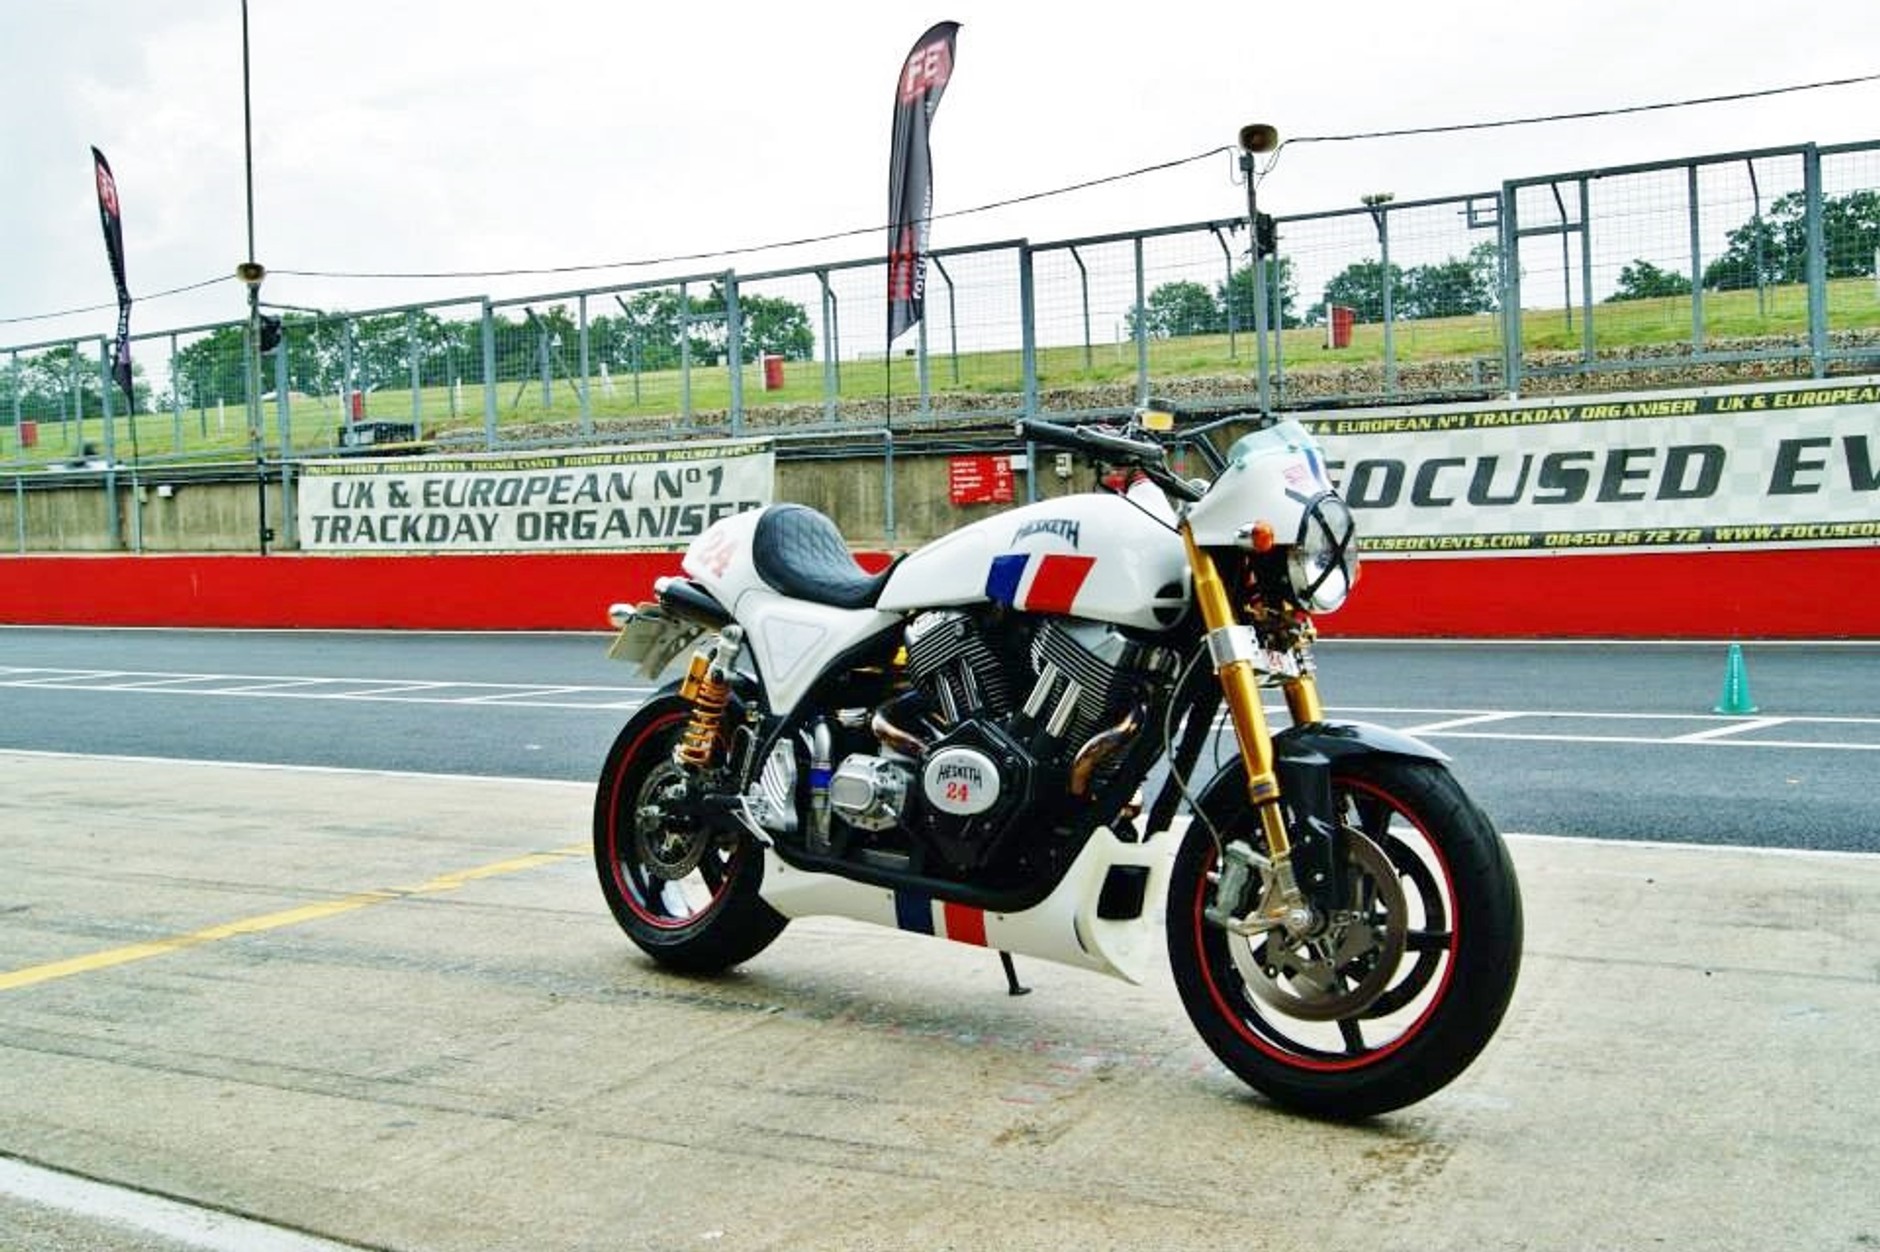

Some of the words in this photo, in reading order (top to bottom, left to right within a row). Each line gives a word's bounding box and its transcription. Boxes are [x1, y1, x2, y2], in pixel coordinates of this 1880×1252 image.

[1318, 421, 1331, 433] &
[1337, 417, 1432, 433] EUROPEAN
[1473, 407, 1575, 427] TRACKDAY
[1580, 399, 1698, 420] ORGANISER
[1716, 396, 1746, 411] UK
[1751, 395, 1767, 409] &
[332, 480, 376, 509] UK
[387, 480, 413, 508] &
[423, 470, 637, 509] EUROPEAN
[311, 512, 499, 544] TRACKDAY
[1358, 533, 1531, 551] CUSEDEVENTS.COM
[1544, 532, 1610, 546] 08450
[945, 781, 970, 803] 24
